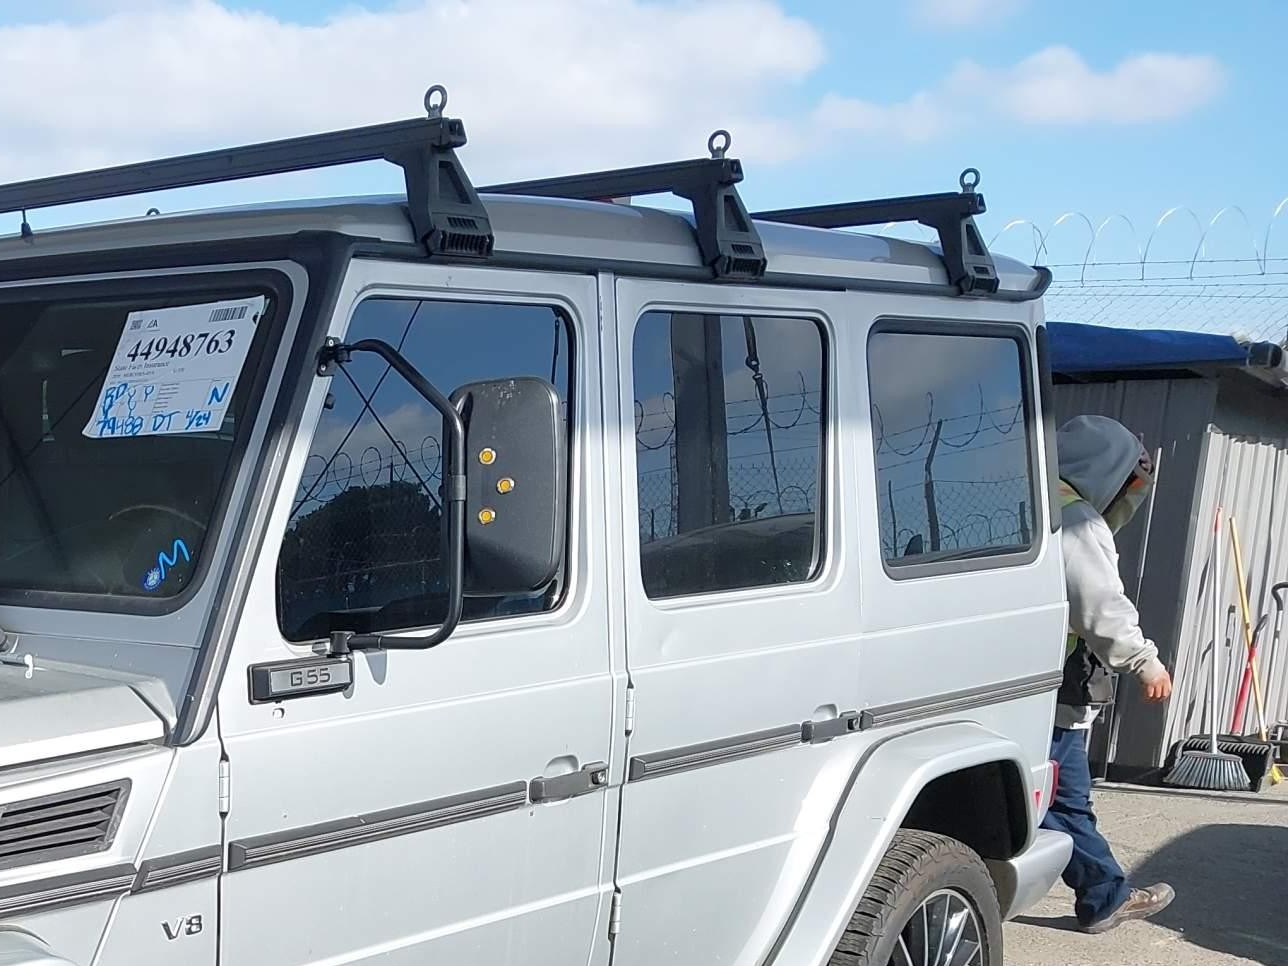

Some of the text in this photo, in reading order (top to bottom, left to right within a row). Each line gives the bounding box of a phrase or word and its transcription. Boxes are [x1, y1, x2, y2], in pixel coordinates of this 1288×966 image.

[127, 329, 236, 363] 44948763
[208, 382, 230, 406] N
[159, 539, 190, 579] M
[161, 914, 203, 940] V8
